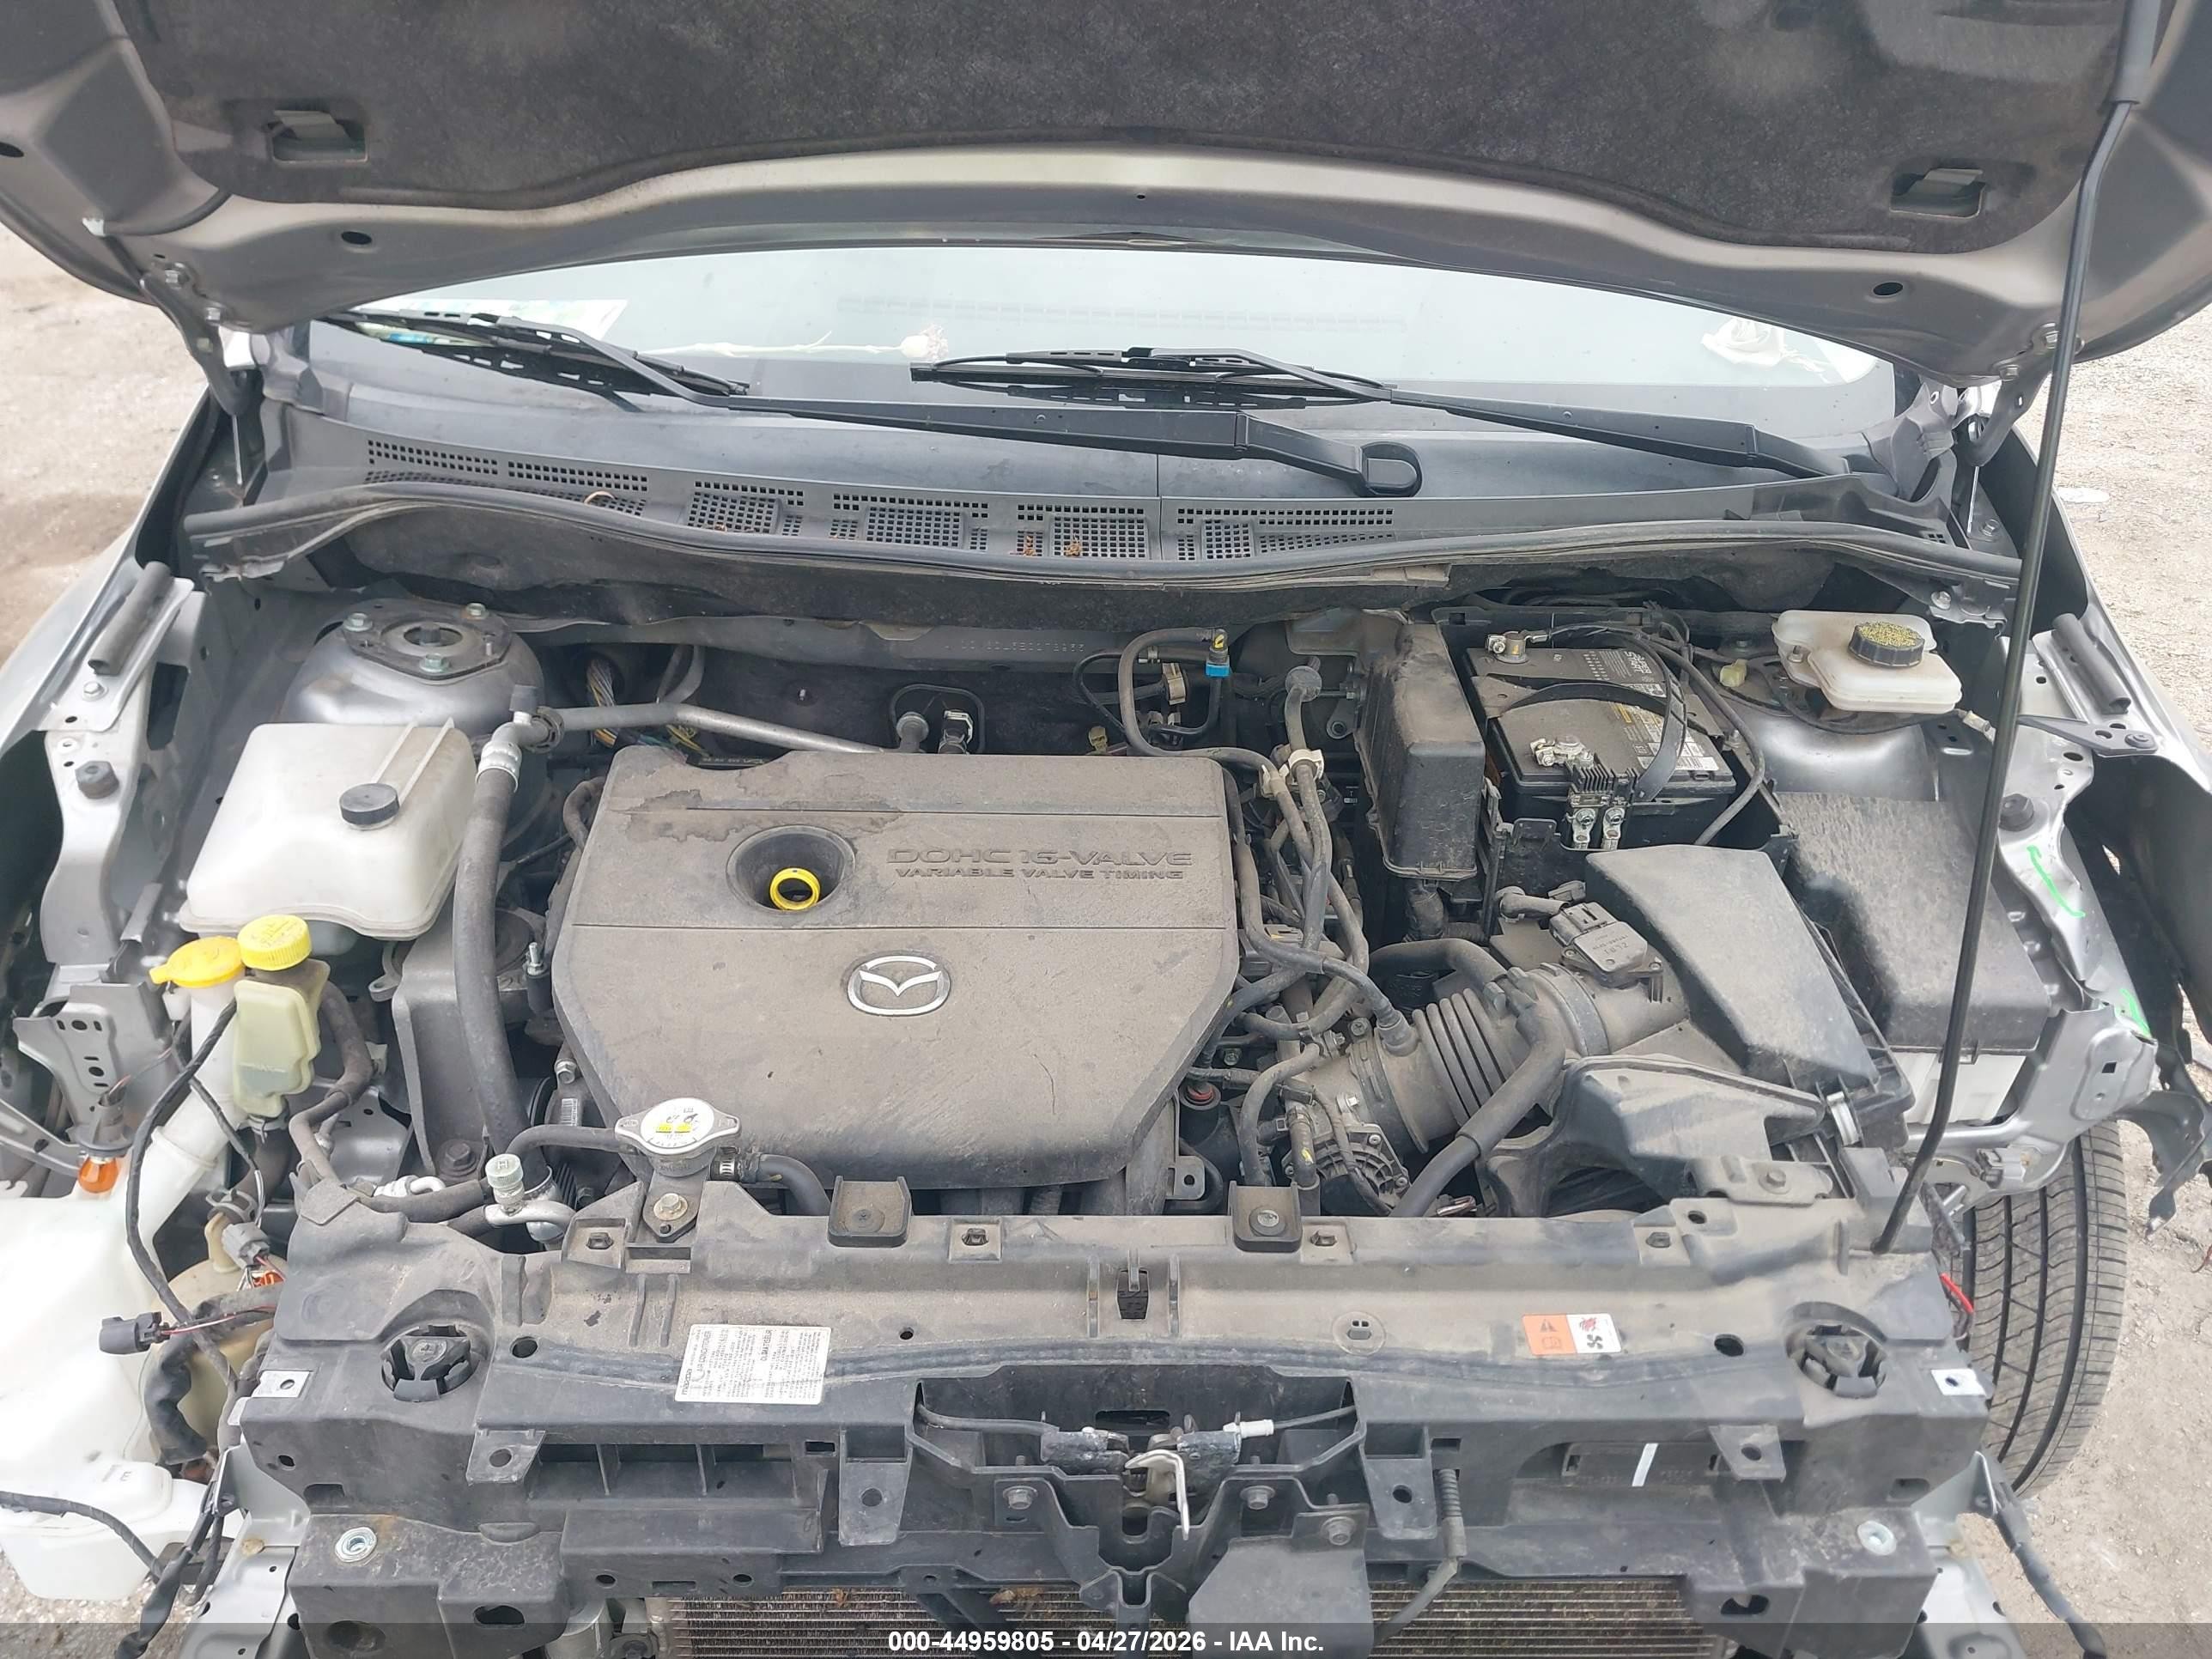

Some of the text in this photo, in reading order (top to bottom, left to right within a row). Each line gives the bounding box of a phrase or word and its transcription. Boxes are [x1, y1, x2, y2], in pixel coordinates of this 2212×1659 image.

[886, 848, 1193, 866] DOHC 16-VALVE
[895, 868, 1183, 880] VARIABLE VALVE TIMING
